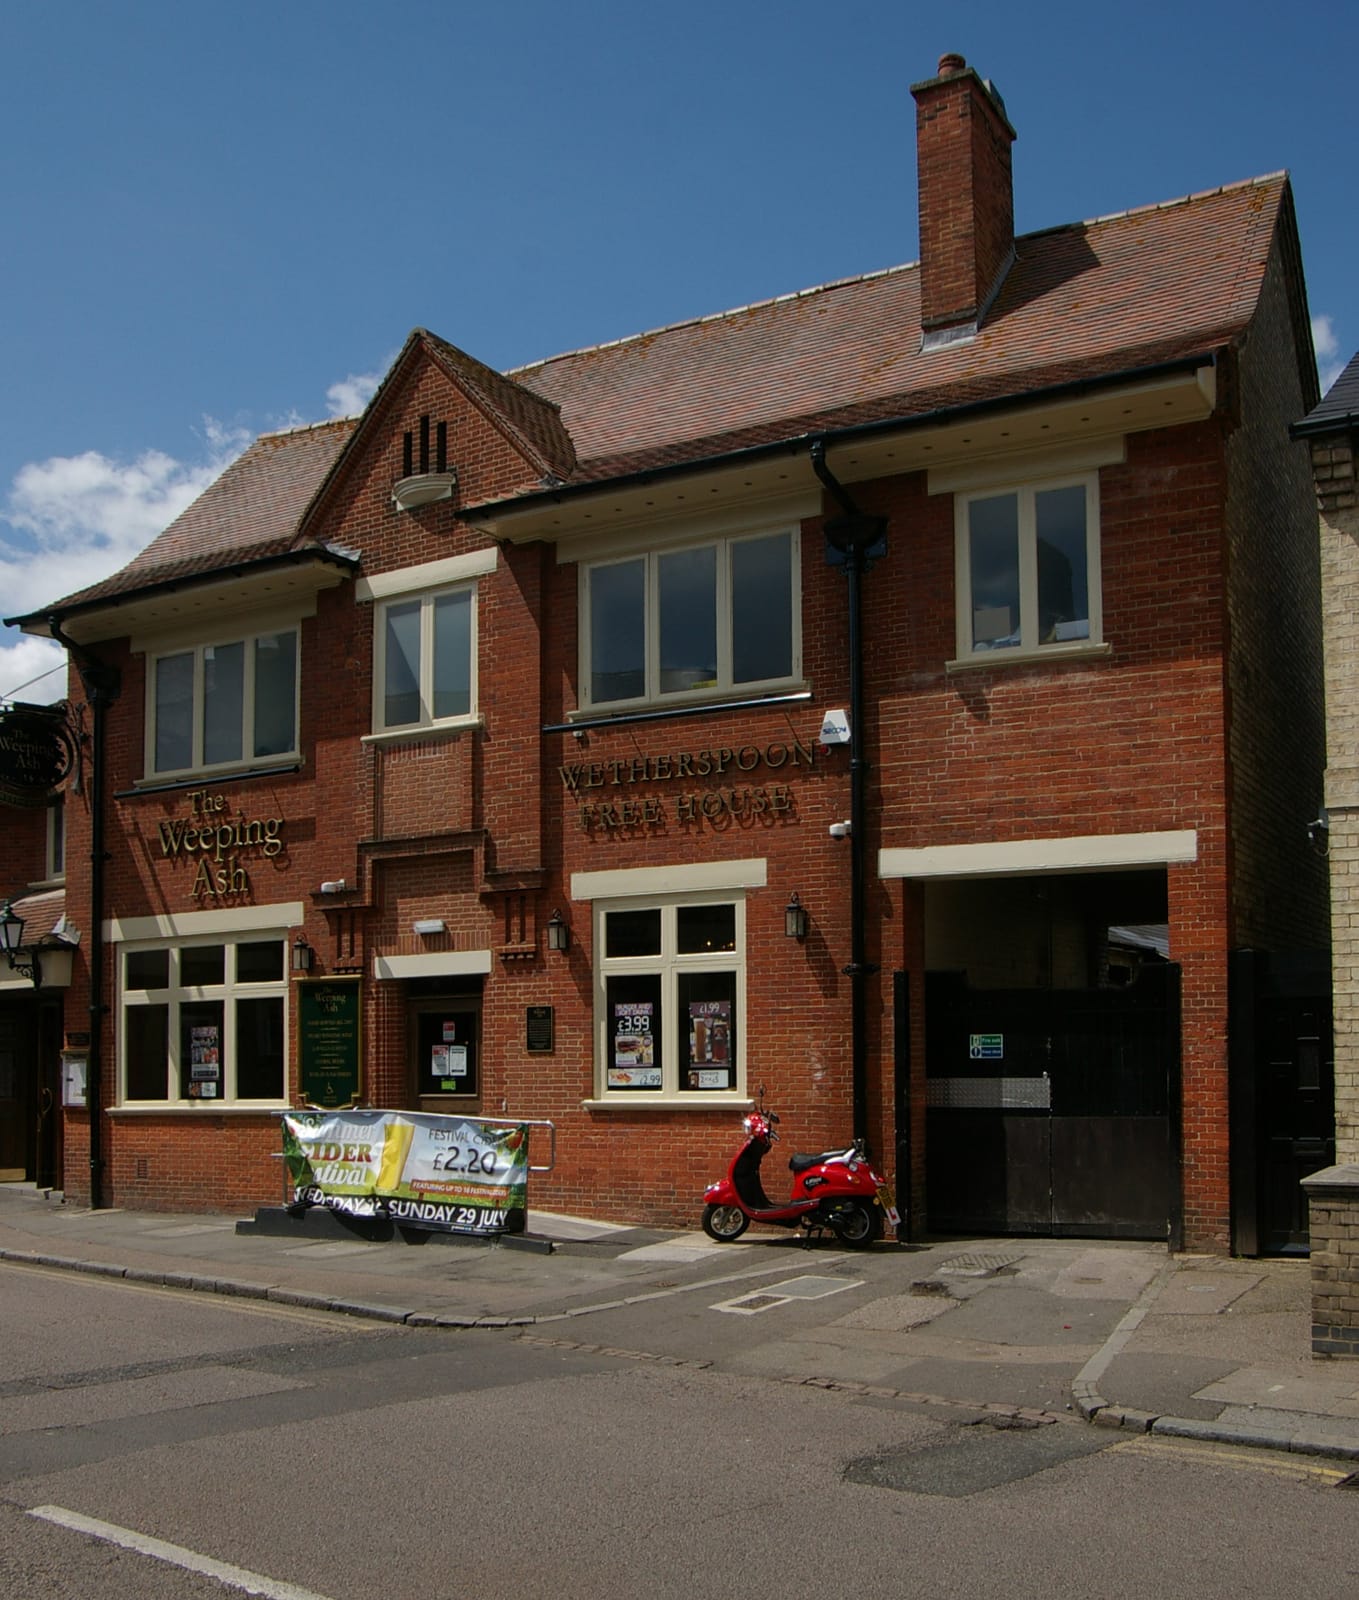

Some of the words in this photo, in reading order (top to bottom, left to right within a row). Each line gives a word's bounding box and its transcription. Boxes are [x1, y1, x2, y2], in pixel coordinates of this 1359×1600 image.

[558, 738, 817, 790] WETHERSPOON
[187, 790, 225, 815] The
[578, 797, 662, 829] FREE
[674, 784, 792, 820] HOUSE
[158, 810, 284, 863] Weeping
[187, 856, 248, 897] Ash
[617, 1016, 650, 1032] £3.99
[428, 1127, 468, 1143] FESTIVAL
[311, 1162, 368, 1186] stival
[432, 1146, 498, 1175] £2.20
[388, 1199, 455, 1222] SUNDAY
[456, 1207, 476, 1224] 29
[476, 1208, 508, 1228] JULY
